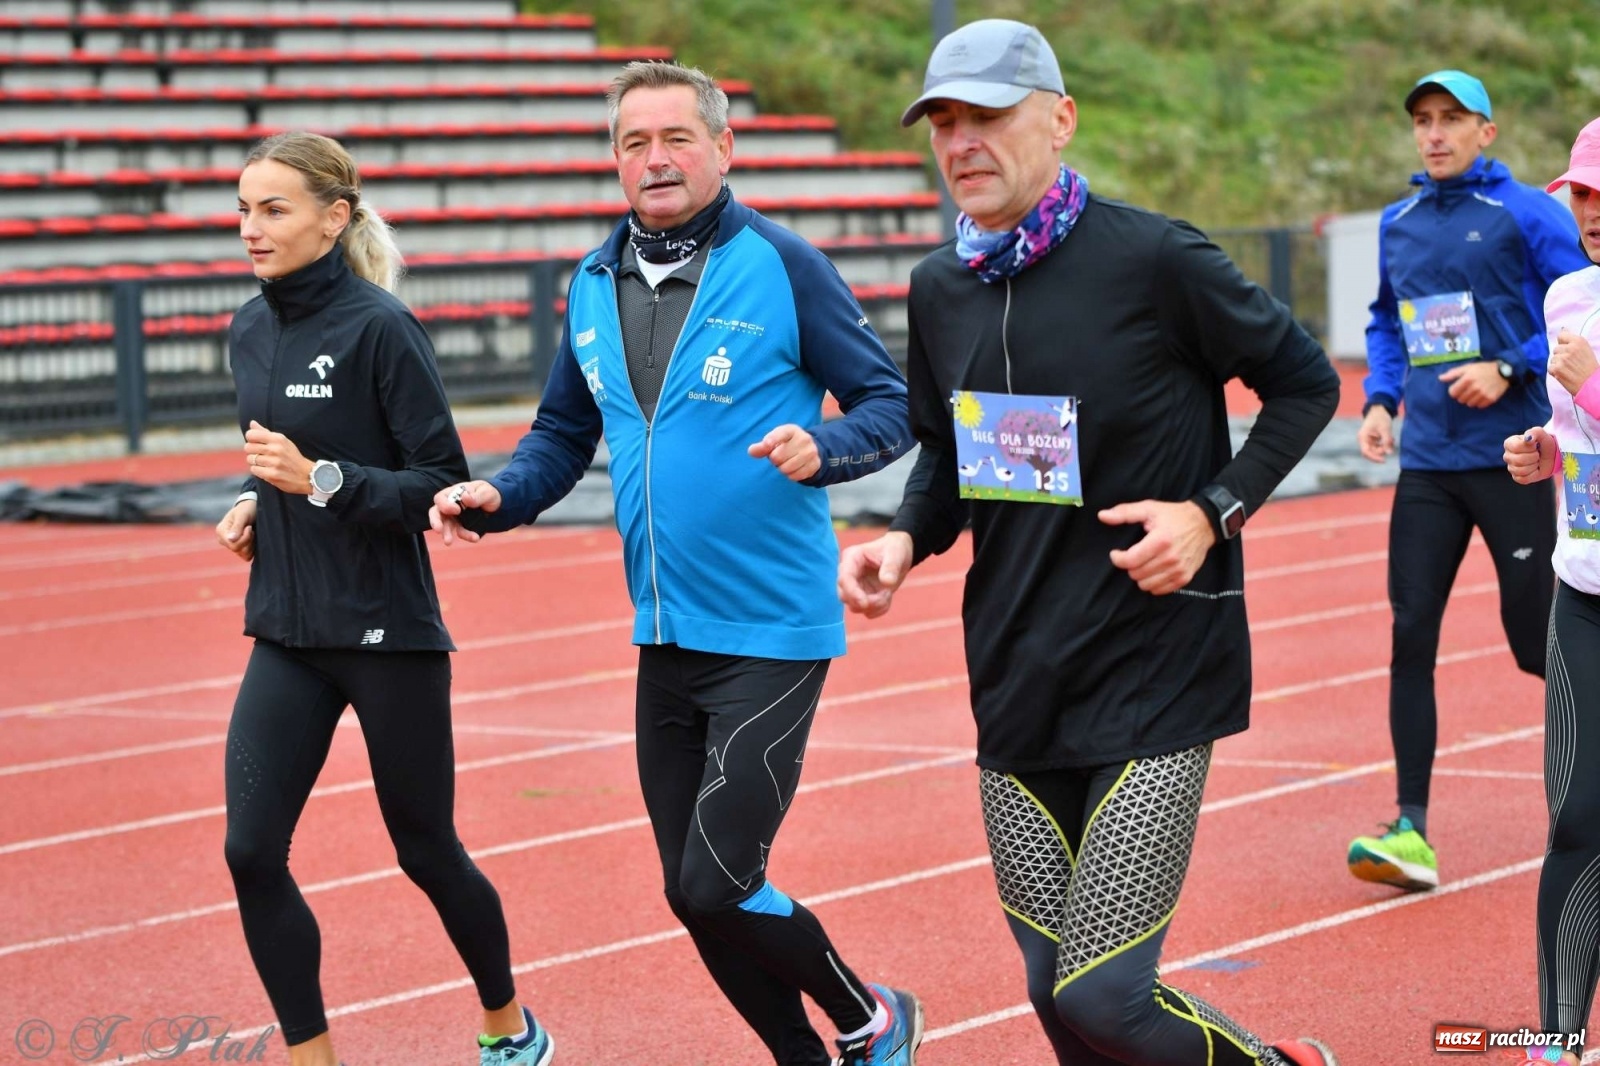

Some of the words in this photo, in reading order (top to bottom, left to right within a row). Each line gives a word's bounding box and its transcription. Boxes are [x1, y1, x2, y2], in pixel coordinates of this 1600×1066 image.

[285, 383, 333, 398] ORLEN
[688, 391, 707, 401] Bank
[710, 393, 733, 404] Polski
[971, 429, 995, 445] BIEG
[1000, 432, 1021, 446] DLA
[1033, 469, 1069, 492] 125
[1572, 483, 1587, 494] BIEG
